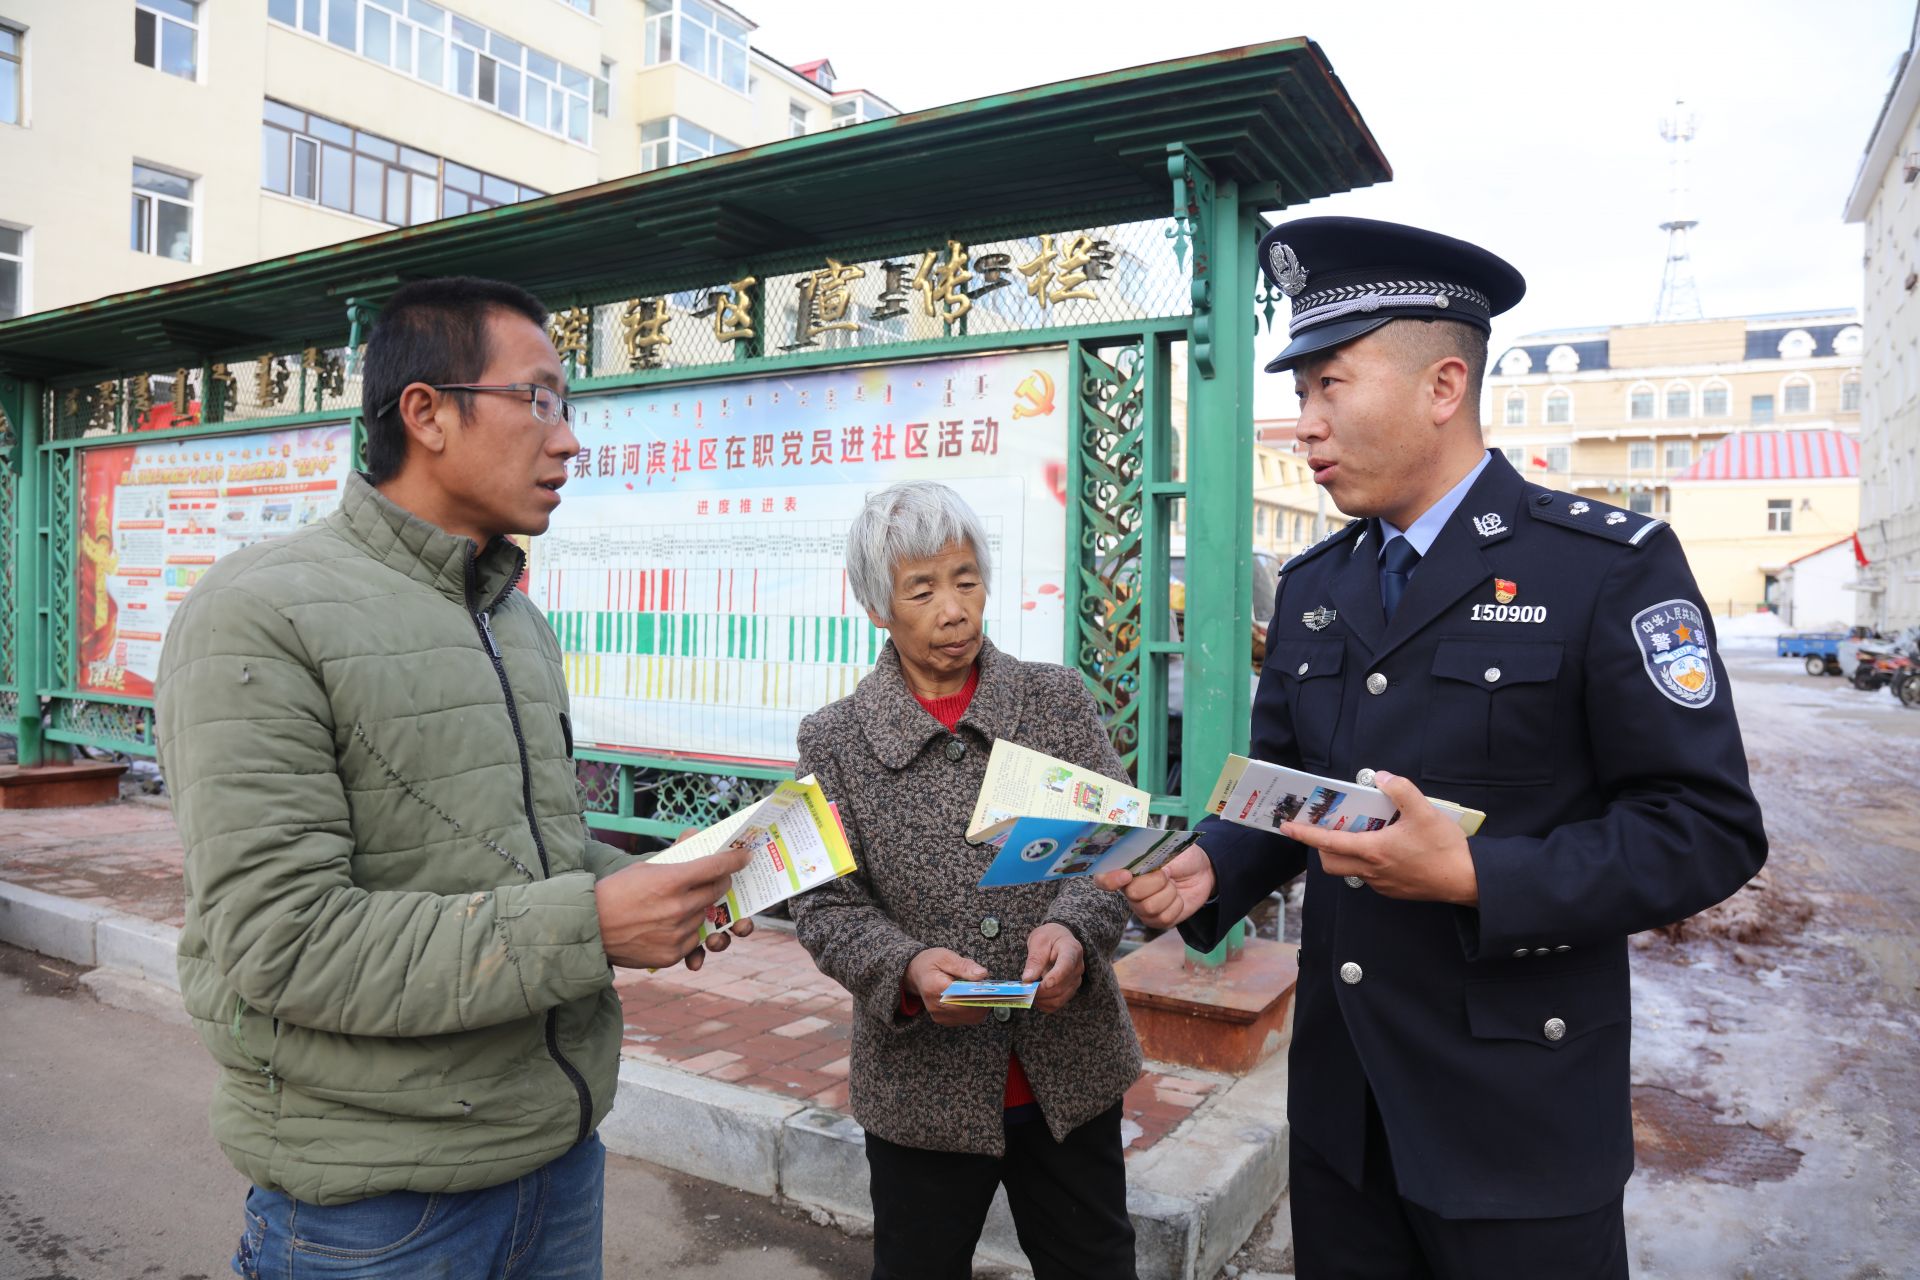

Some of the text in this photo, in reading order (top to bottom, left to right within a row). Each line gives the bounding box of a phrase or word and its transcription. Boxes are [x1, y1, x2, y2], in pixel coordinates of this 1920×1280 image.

[563, 416, 998, 479] 泉街河滨社区在职党员进社区活动
[696, 495, 798, 516] 进度推进表
[1470, 603, 1547, 624] 150900
